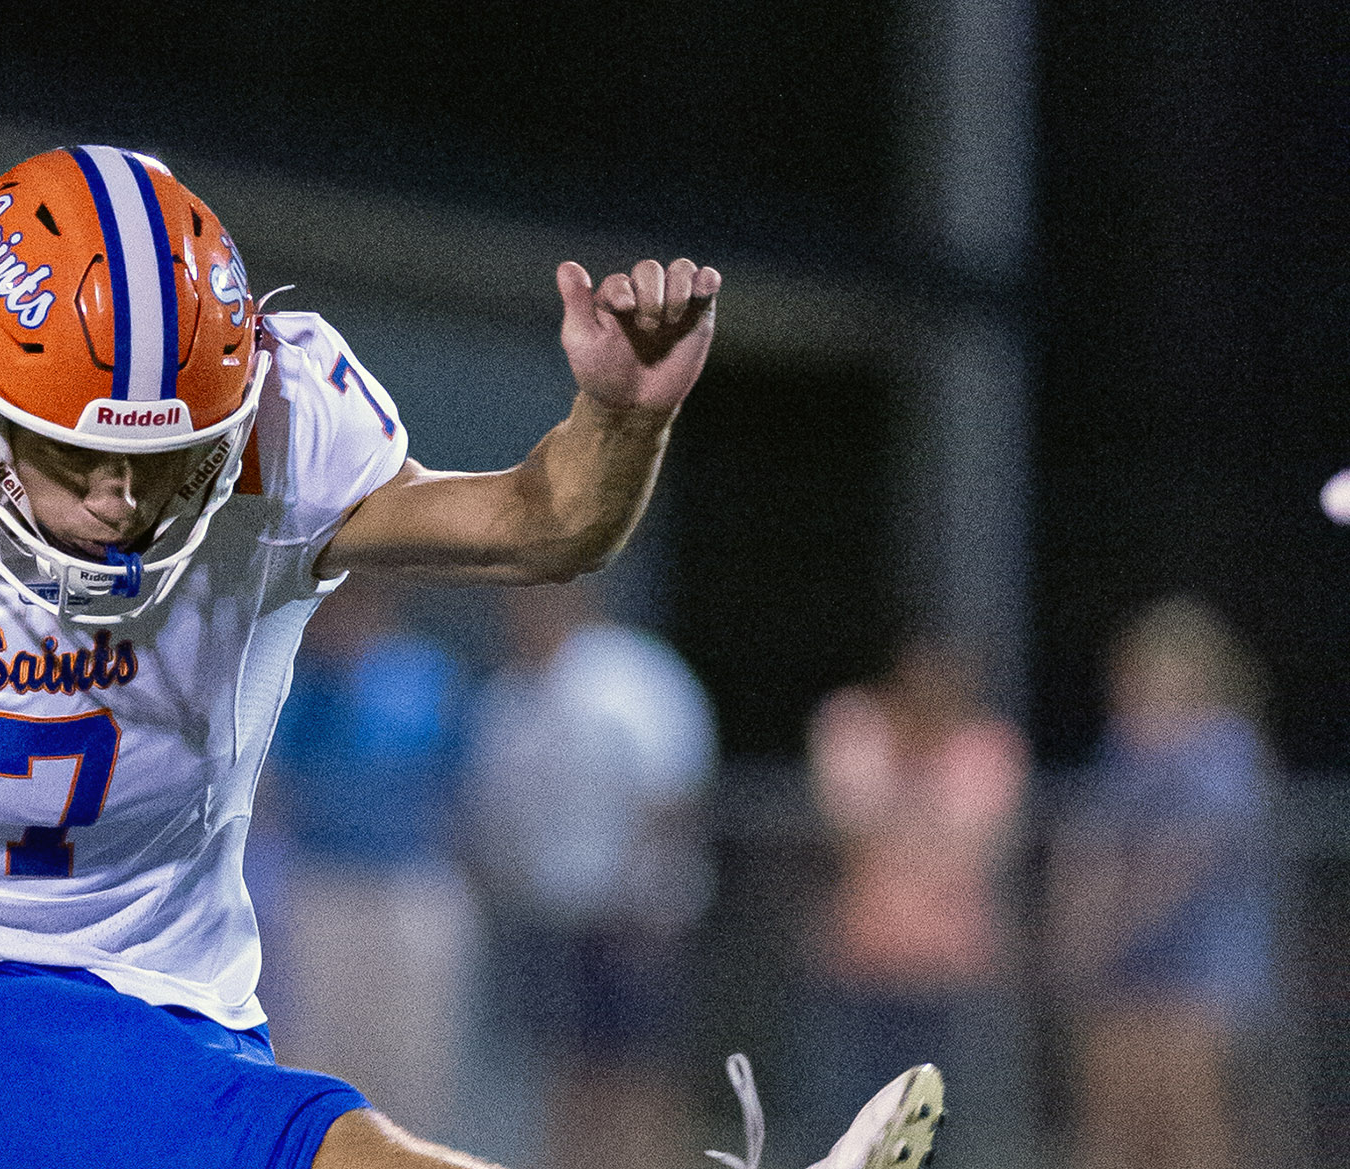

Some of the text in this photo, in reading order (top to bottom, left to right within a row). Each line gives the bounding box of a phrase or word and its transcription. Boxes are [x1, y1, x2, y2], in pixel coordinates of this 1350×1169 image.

[97, 406, 181, 428] Riddell
[327, 351, 397, 441] 7
[177, 440, 231, 501] Riddell
